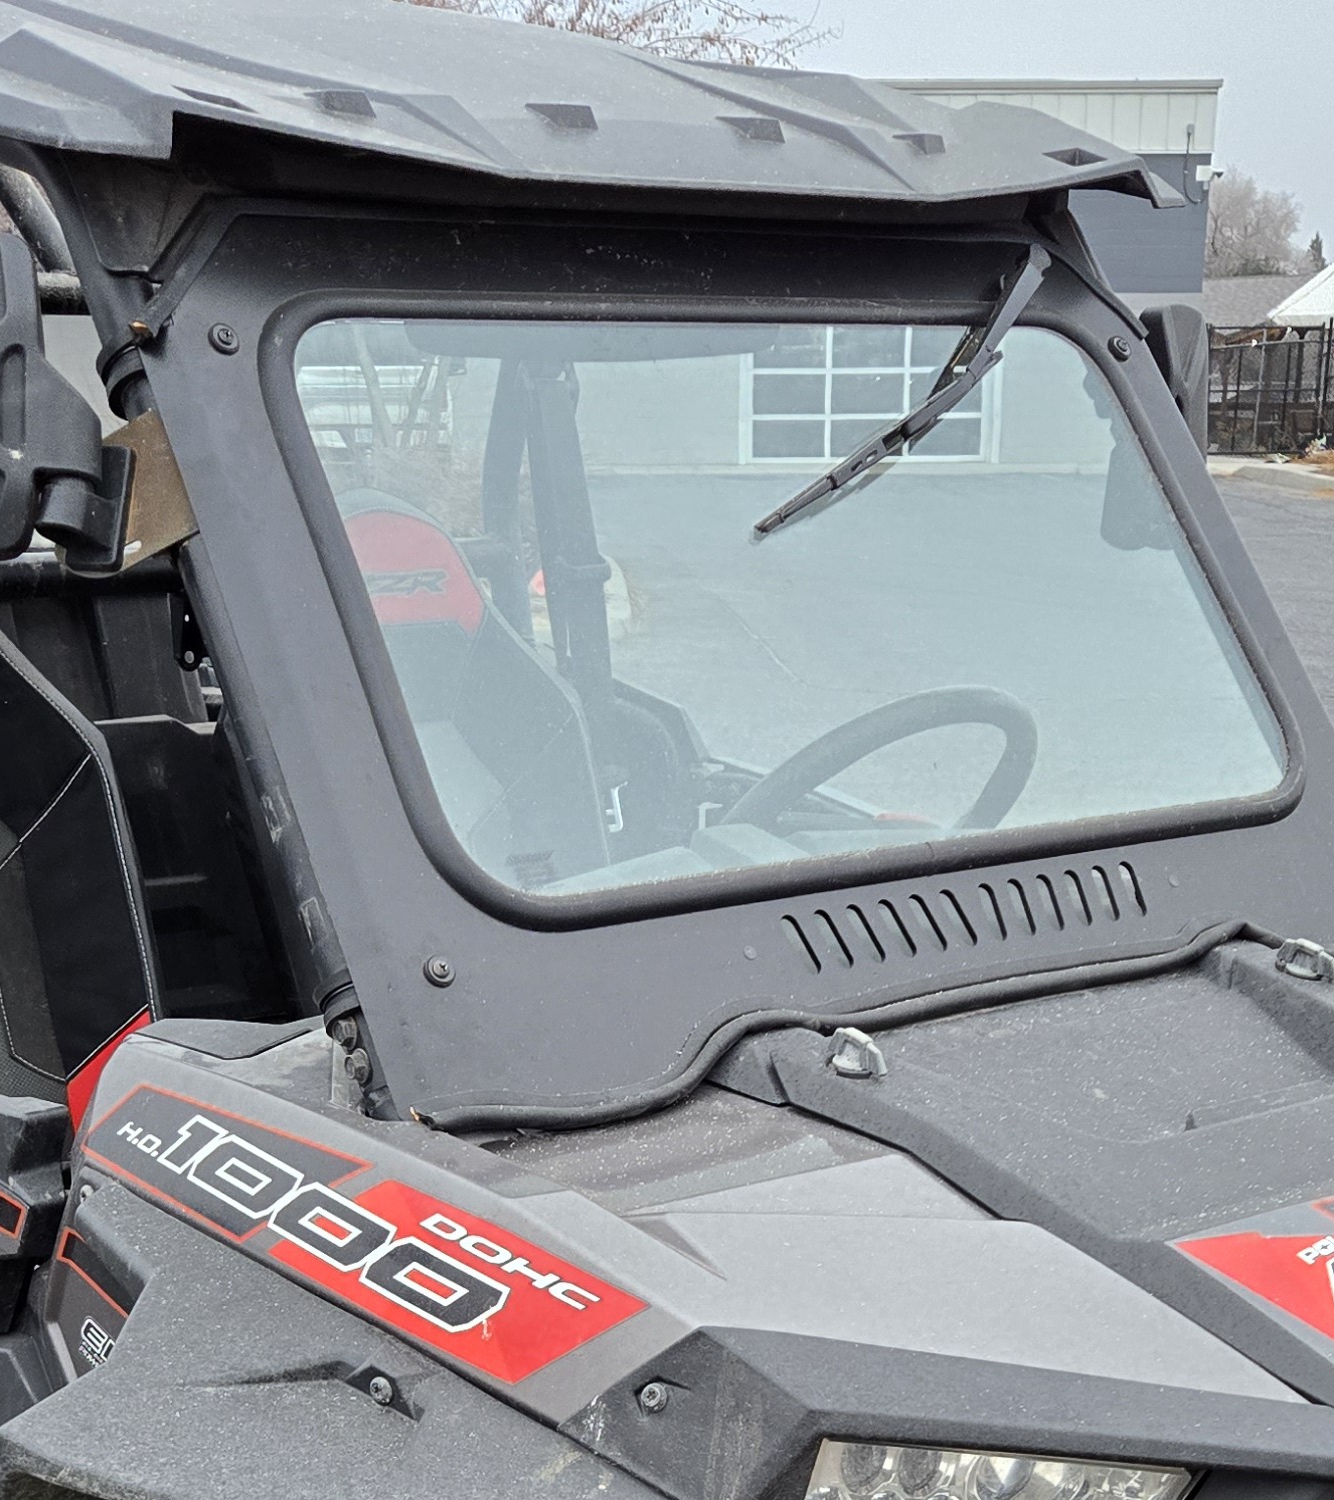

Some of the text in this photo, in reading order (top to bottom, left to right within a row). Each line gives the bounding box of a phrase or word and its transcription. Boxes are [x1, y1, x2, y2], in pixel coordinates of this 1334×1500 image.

[361, 568, 449, 598] ZR
[116, 1114, 511, 1333] H.O. 1000
[419, 1213, 601, 1311] DOHC
